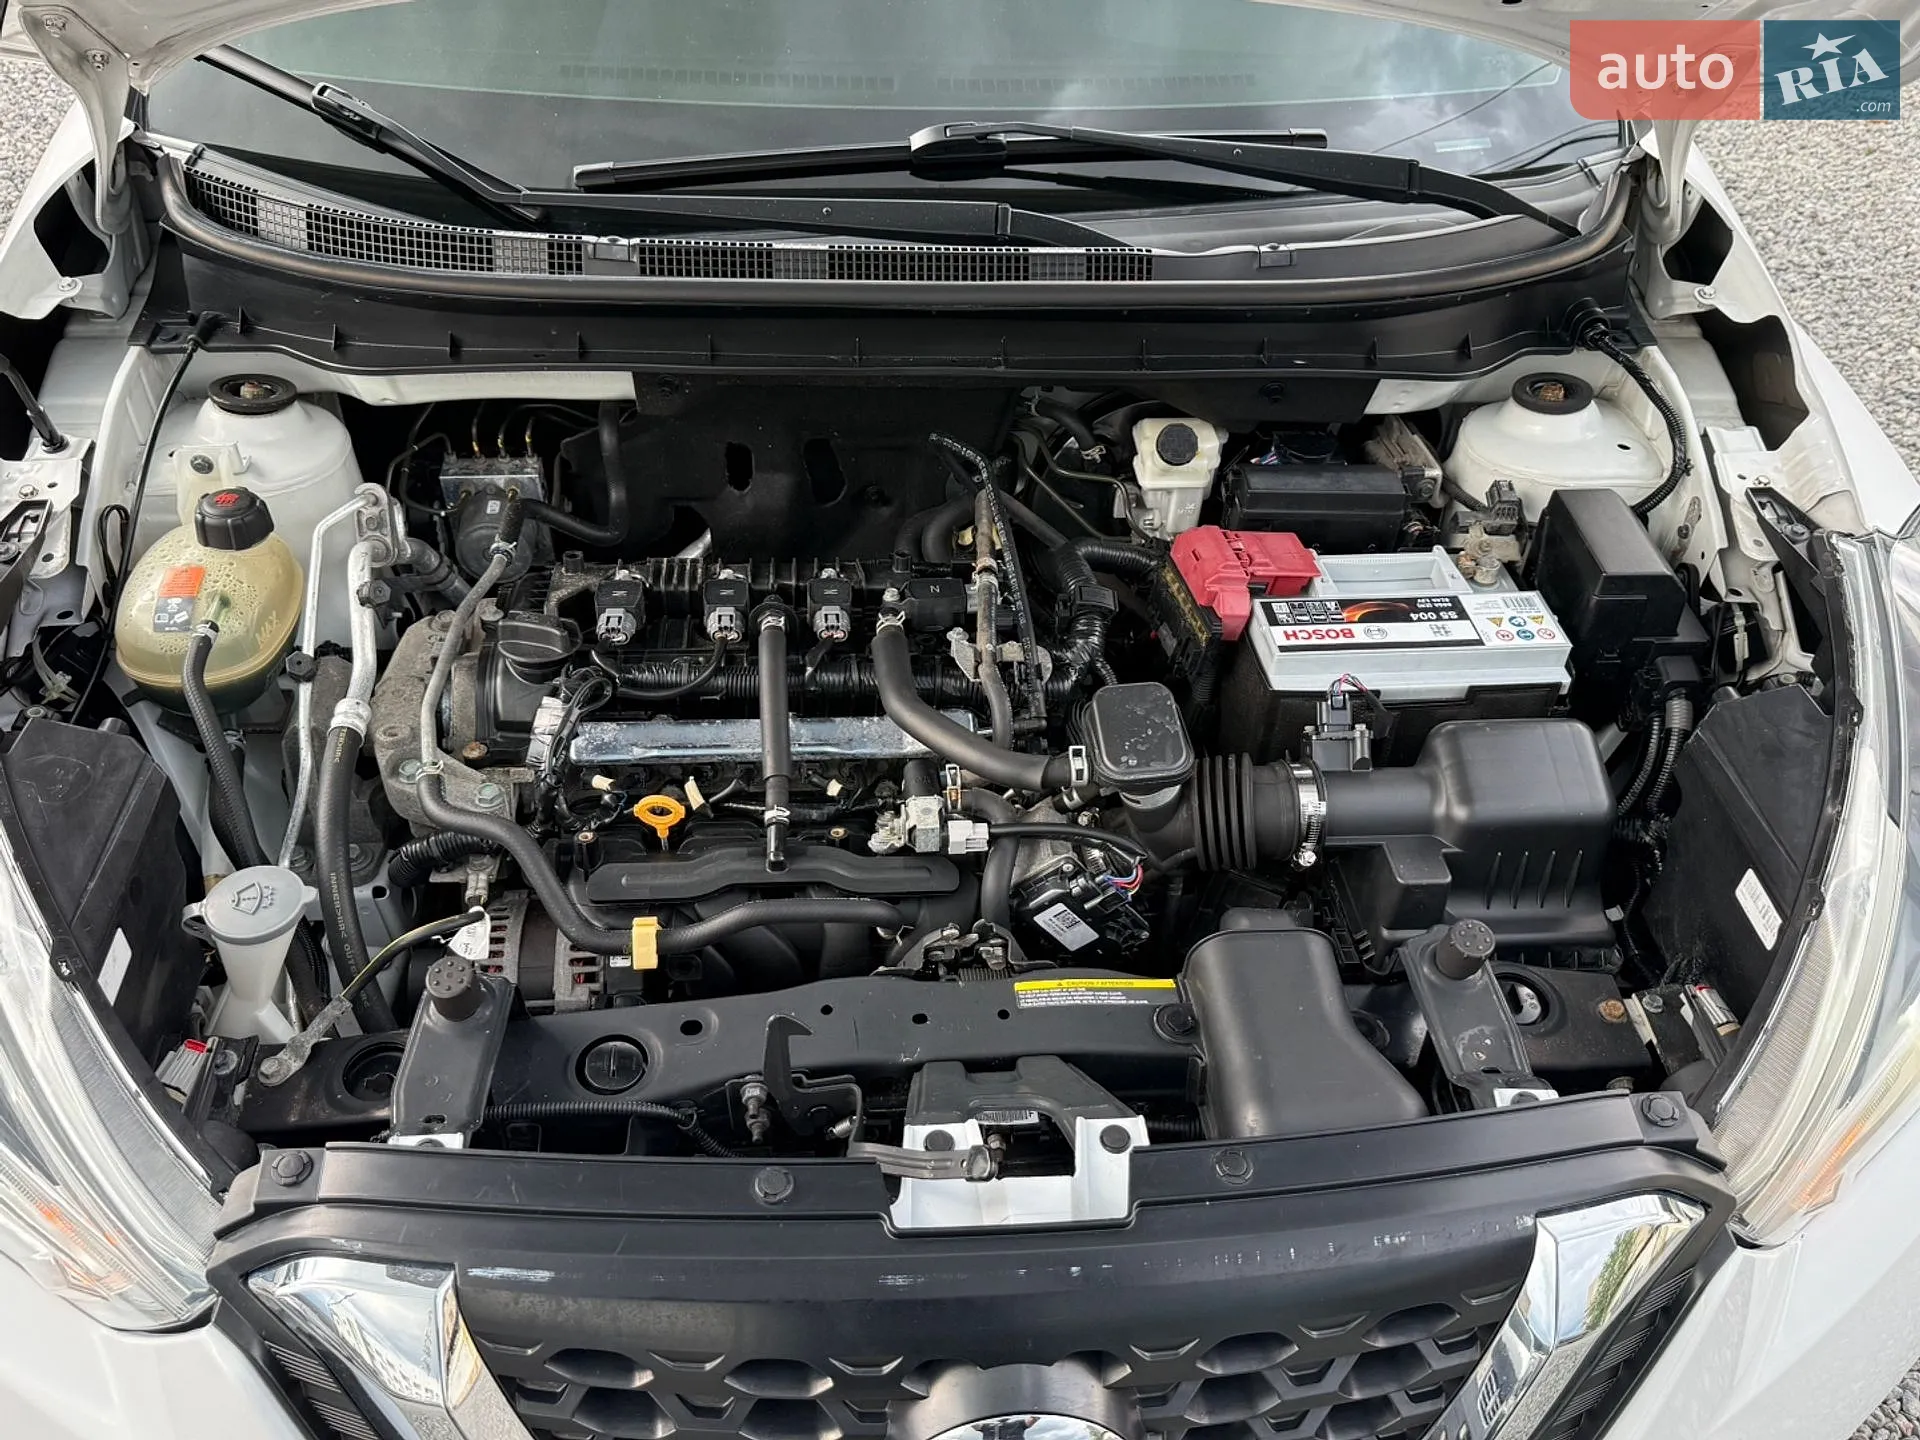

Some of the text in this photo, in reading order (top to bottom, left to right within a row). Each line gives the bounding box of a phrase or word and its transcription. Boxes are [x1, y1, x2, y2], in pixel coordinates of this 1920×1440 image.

[930, 585, 940, 593] N
[1410, 611, 1437, 620] 004
[254, 609, 281, 649] MAX
[1282, 628, 1355, 641] BOSCH
